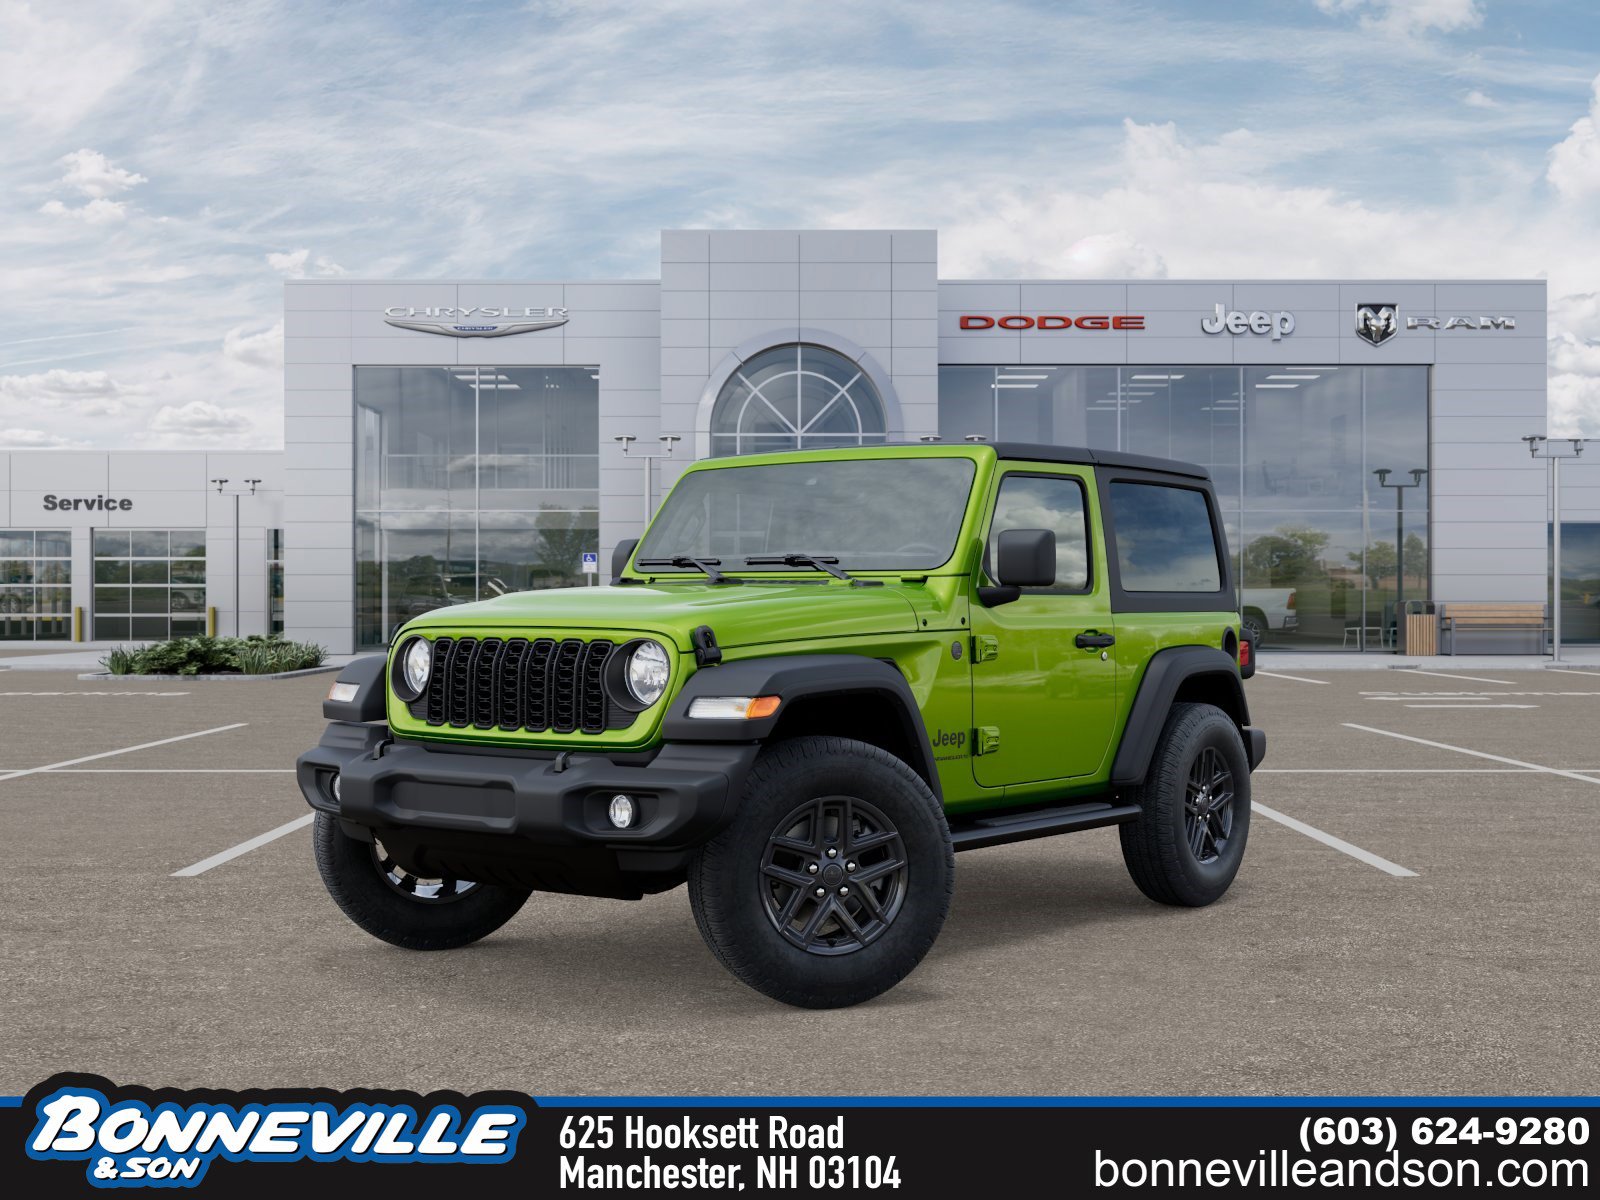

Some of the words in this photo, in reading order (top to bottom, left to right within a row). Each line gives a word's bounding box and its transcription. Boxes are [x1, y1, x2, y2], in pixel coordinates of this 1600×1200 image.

[384, 307, 569, 317] CHRYSLER
[959, 315, 1145, 330] DODGE
[1201, 303, 1295, 341] Jeep
[1406, 316, 1515, 330] RAM
[43, 494, 133, 511] Service
[932, 728, 966, 749] Jeep
